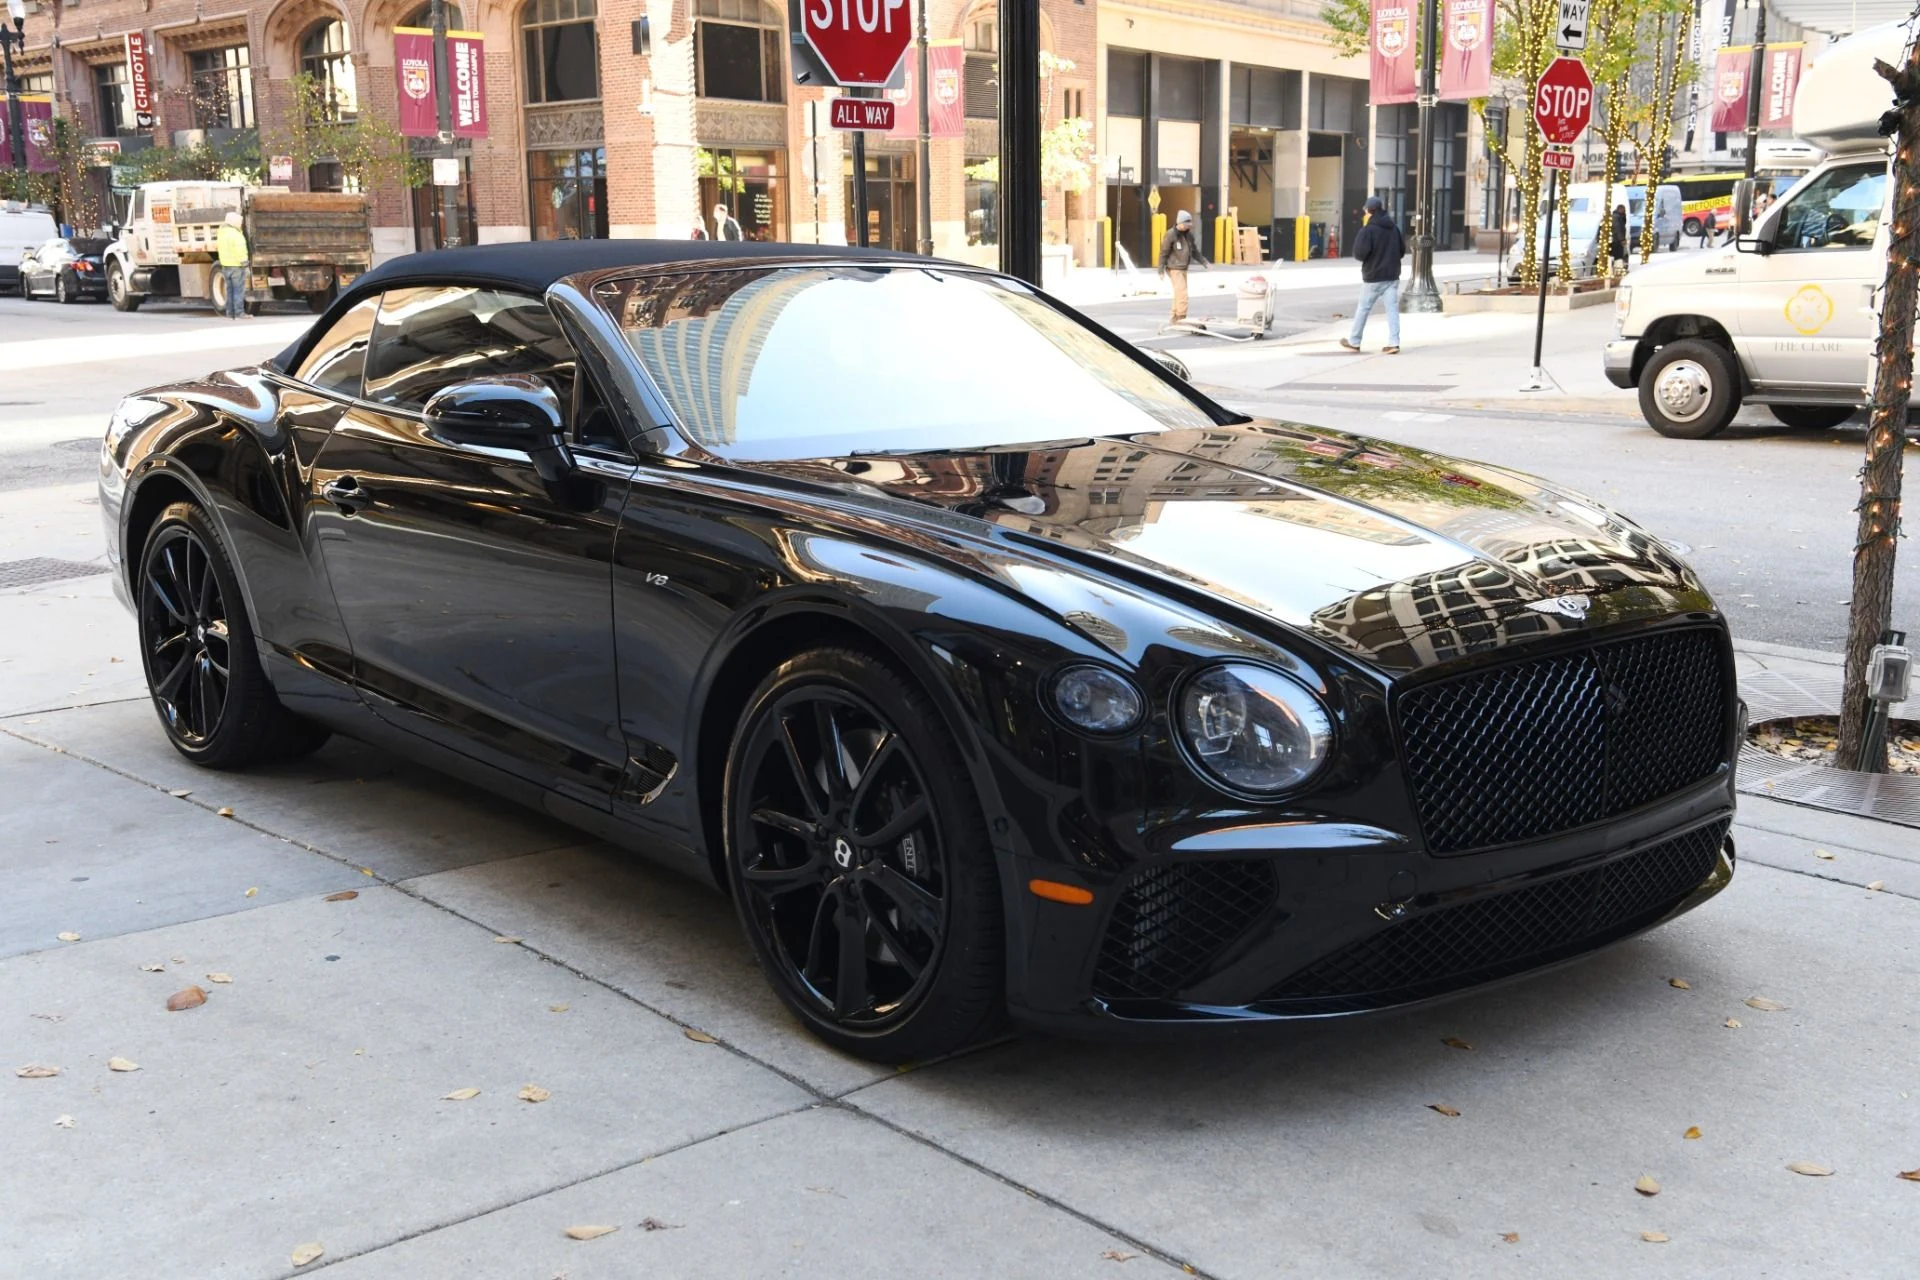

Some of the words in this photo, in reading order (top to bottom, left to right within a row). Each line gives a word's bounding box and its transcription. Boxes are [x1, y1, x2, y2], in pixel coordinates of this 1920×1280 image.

[1376, 8, 1408, 17] LOYOLA
[1562, 3, 1586, 20] WAY
[402, 58, 428, 67] LOYOLA
[131, 37, 148, 108] CHIPOTLE
[455, 42, 473, 127] WELCOME
[1769, 52, 1787, 121] WELCOME
[1539, 84, 1590, 118] STOP
[837, 105, 860, 124] ALL
[865, 106, 889, 125] WAY
[1545, 154, 1559, 165] ALL
[1560, 156, 1572, 167] WAY
[1774, 342, 1798, 352] THE
[1801, 342, 1841, 352] CLARE
[645, 572, 669, 586] V8
